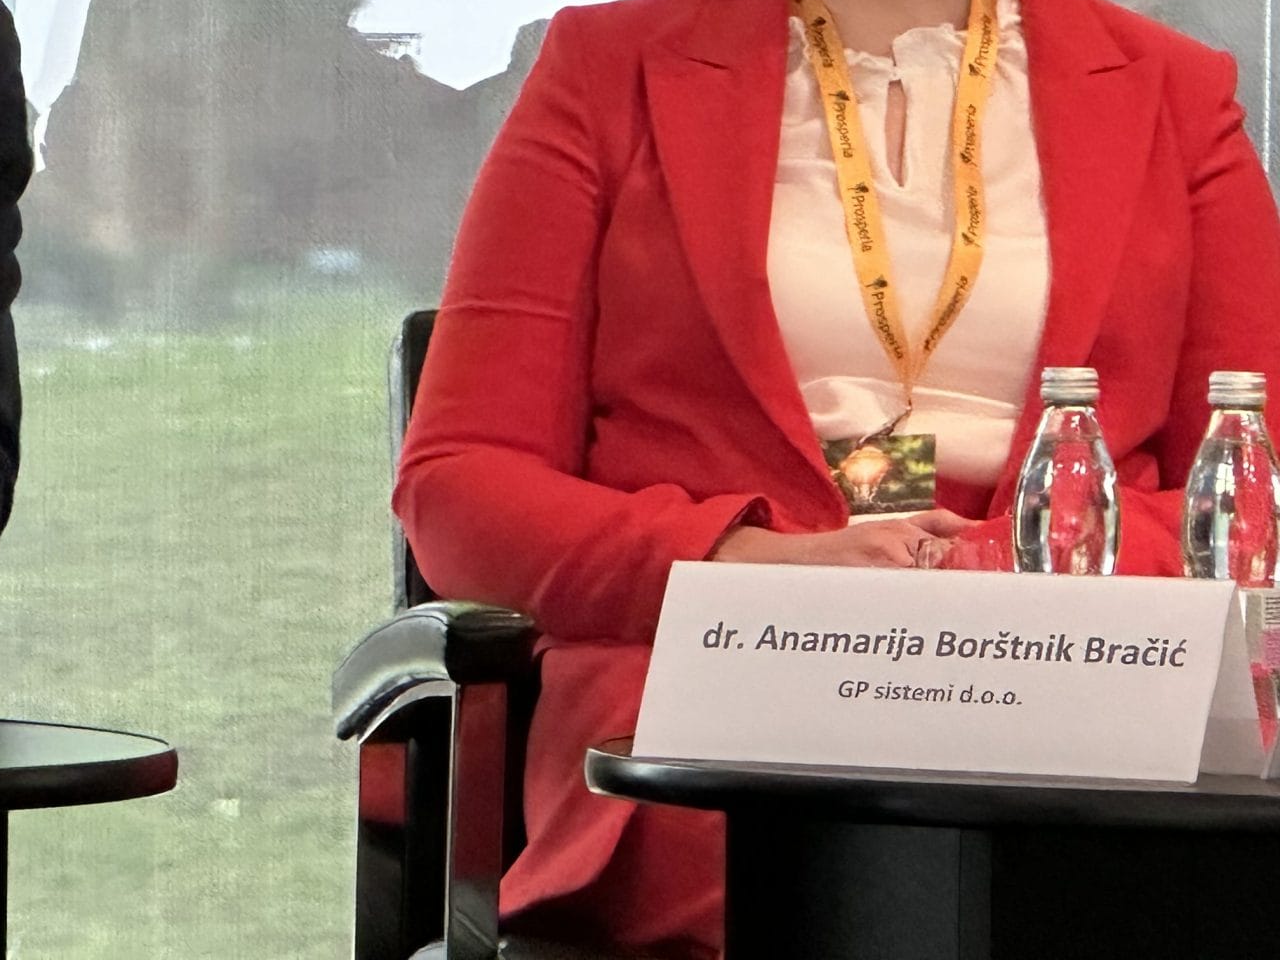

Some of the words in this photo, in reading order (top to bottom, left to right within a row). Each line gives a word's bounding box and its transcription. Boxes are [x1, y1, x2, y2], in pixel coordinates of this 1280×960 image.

[702, 621, 744, 651] dr.
[754, 624, 925, 663] Anamarija
[935, 630, 1075, 663] Borštnik
[1083, 637, 1187, 668] Bračić
[837, 679, 870, 700] GP
[873, 682, 954, 704] sistemi
[959, 684, 1023, 707] d.o.o.
